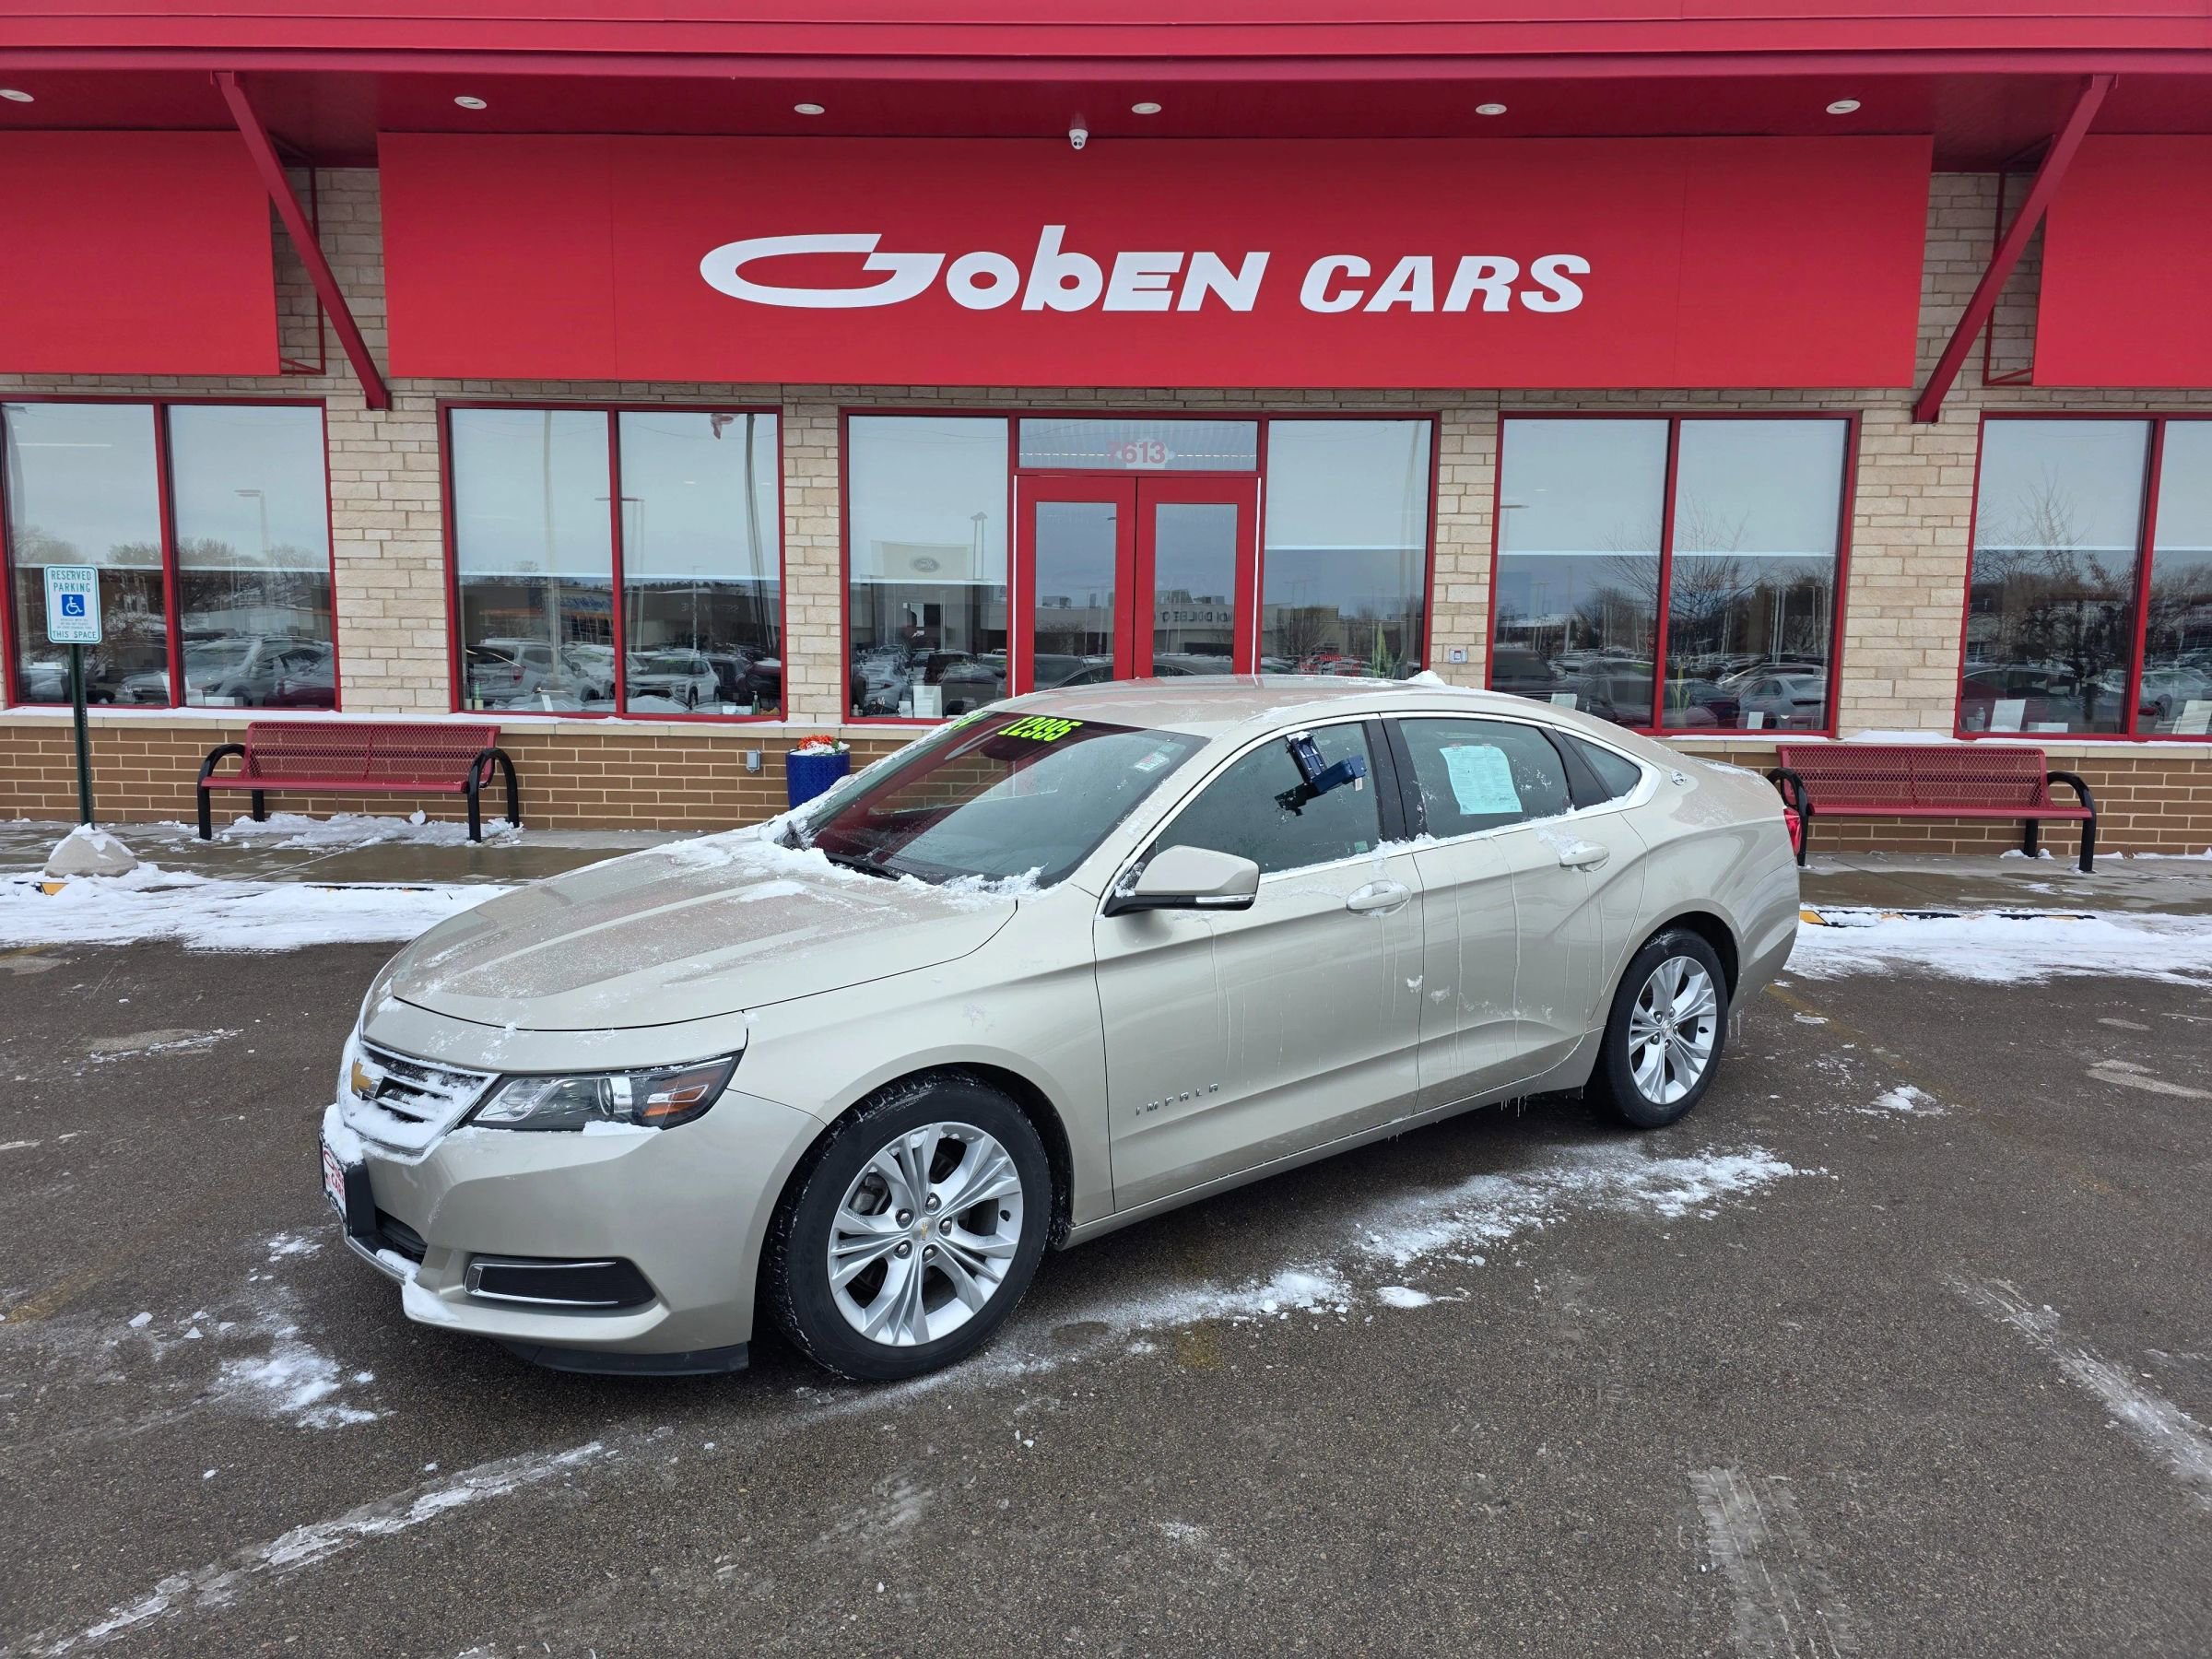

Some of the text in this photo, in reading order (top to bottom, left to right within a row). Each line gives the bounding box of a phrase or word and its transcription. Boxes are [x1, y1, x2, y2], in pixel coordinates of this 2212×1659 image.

[1300, 254, 1590, 312] CARS
[1108, 441, 1166, 464] 7613
[51, 570, 92, 581] RESERVED
[53, 582, 91, 593] PARKING
[53, 629, 97, 639] THIS SPACE
[997, 716, 1083, 742] 12995
[1135, 1083, 1218, 1116] IMPALA
